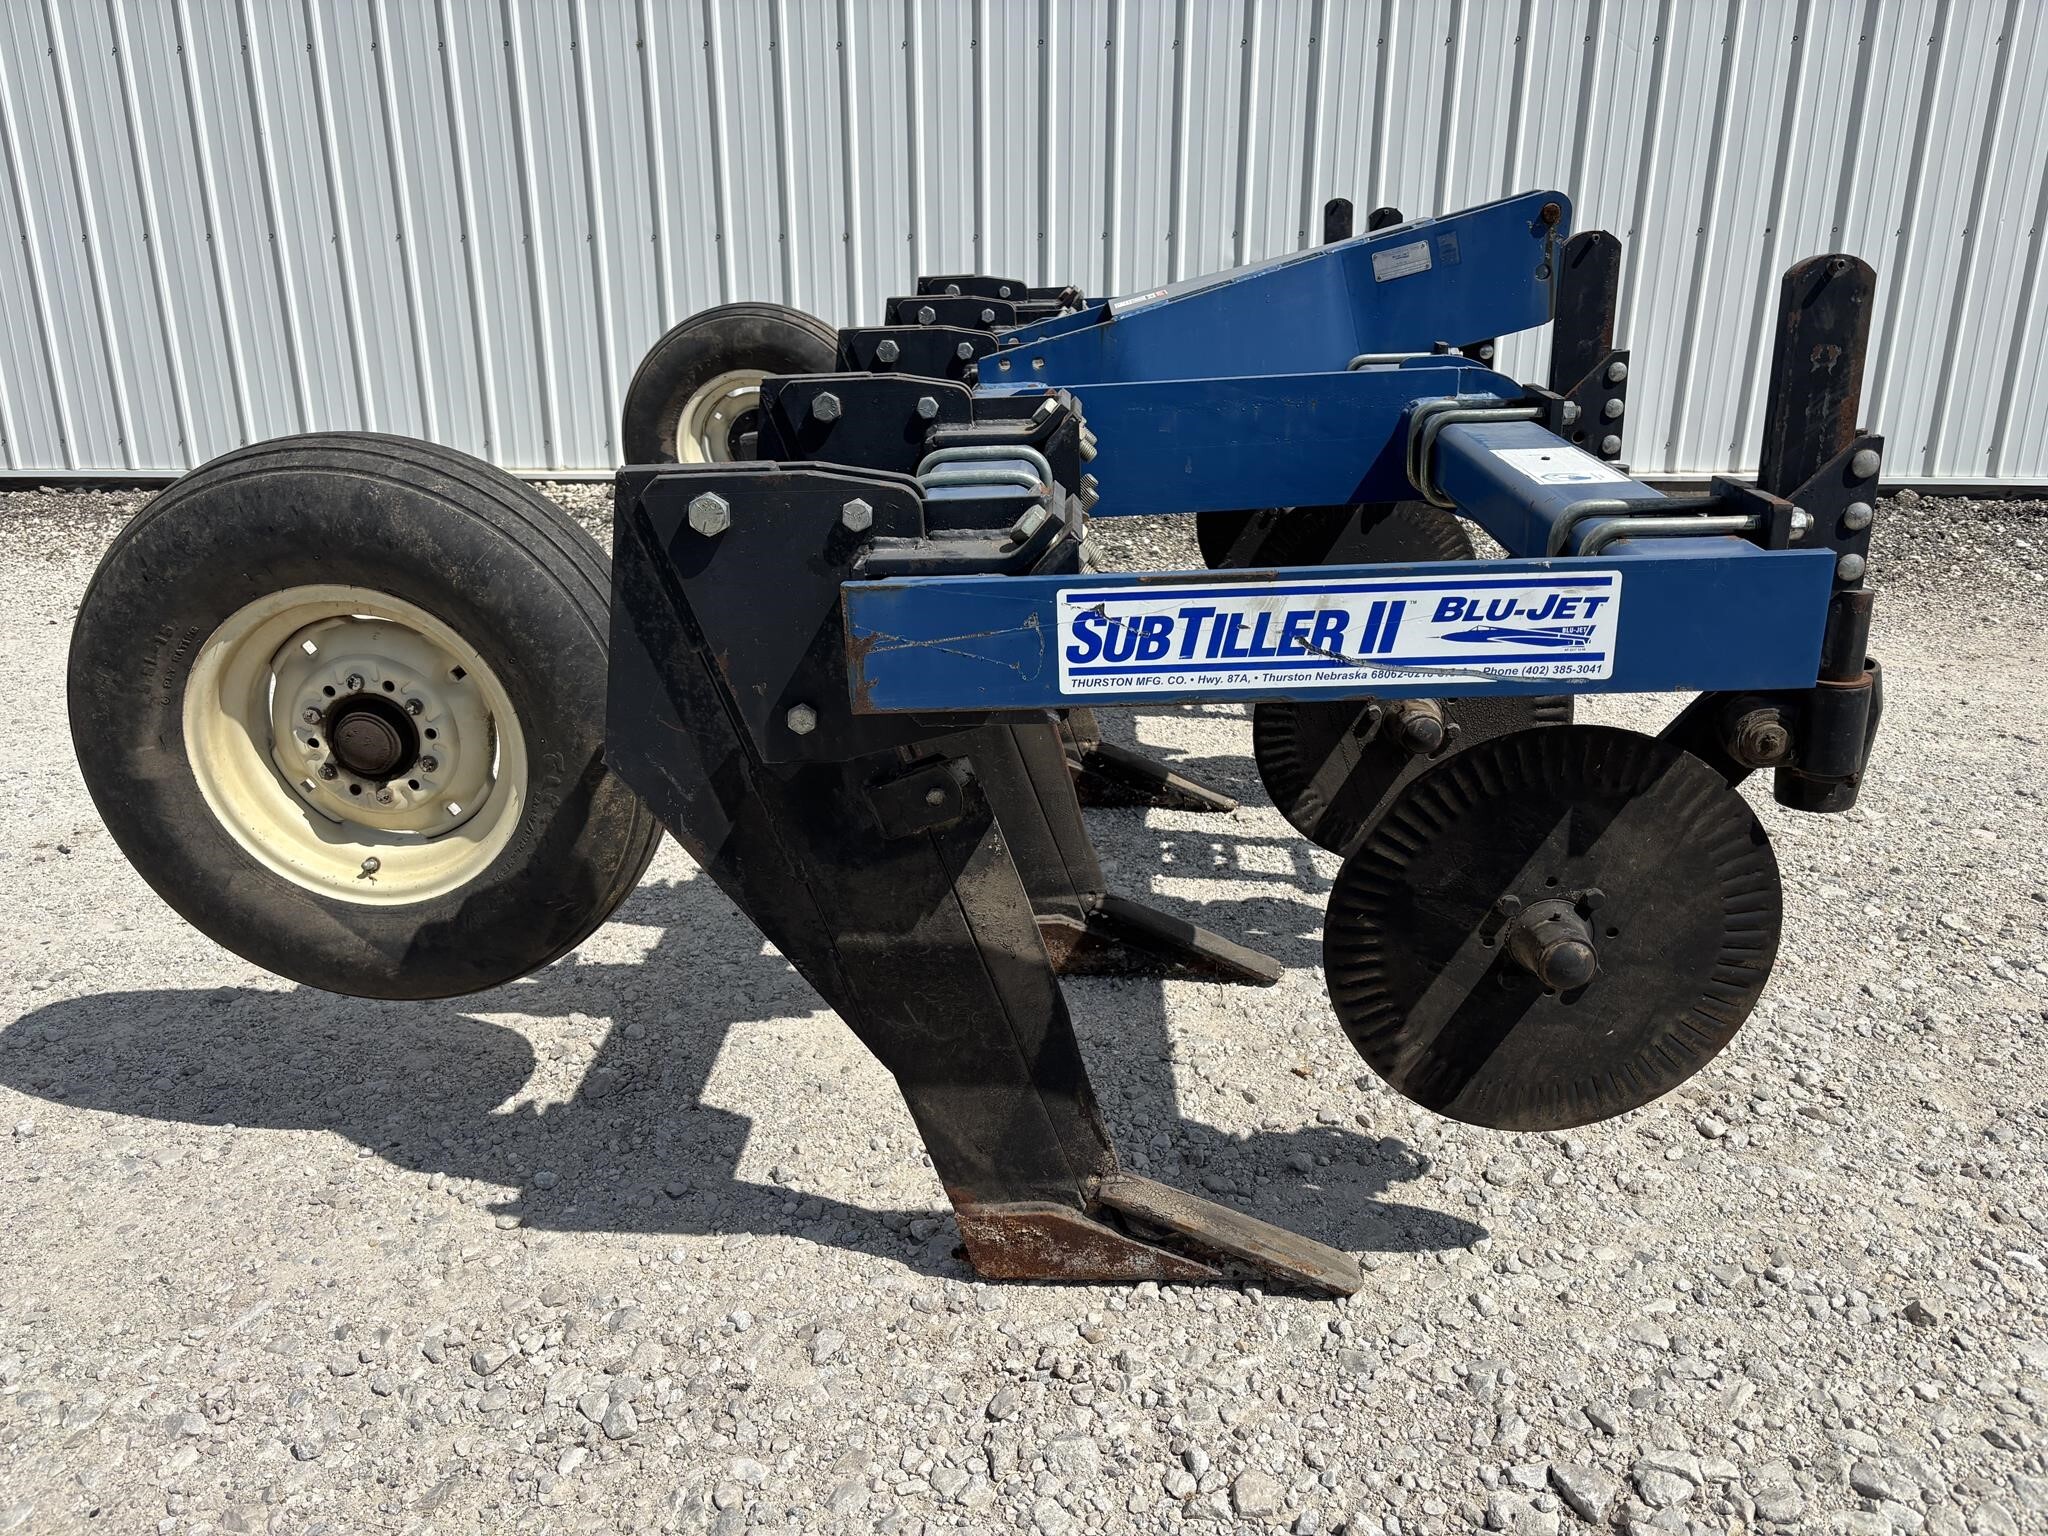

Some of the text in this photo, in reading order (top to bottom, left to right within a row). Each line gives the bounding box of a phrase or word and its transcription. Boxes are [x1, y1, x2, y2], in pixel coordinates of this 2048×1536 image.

[1431, 594, 1610, 623] BLU-JET
[1358, 600, 1407, 654] II
[1562, 626, 1588, 634] BLU-JET
[172, 626, 200, 662] RATING
[1071, 677, 1133, 688] THURSTON
[1136, 676, 1164, 686] MFG.
[1168, 675, 1187, 685] CO.
[1197, 675, 1223, 685] Hwy.
[1262, 673, 1311, 682] Thurston
[1315, 671, 1367, 681] Nebraska
[1483, 666, 1519, 676] Phone
[1522, 665, 1549, 677] (402)
[1553, 664, 1602, 675] 385-3041
